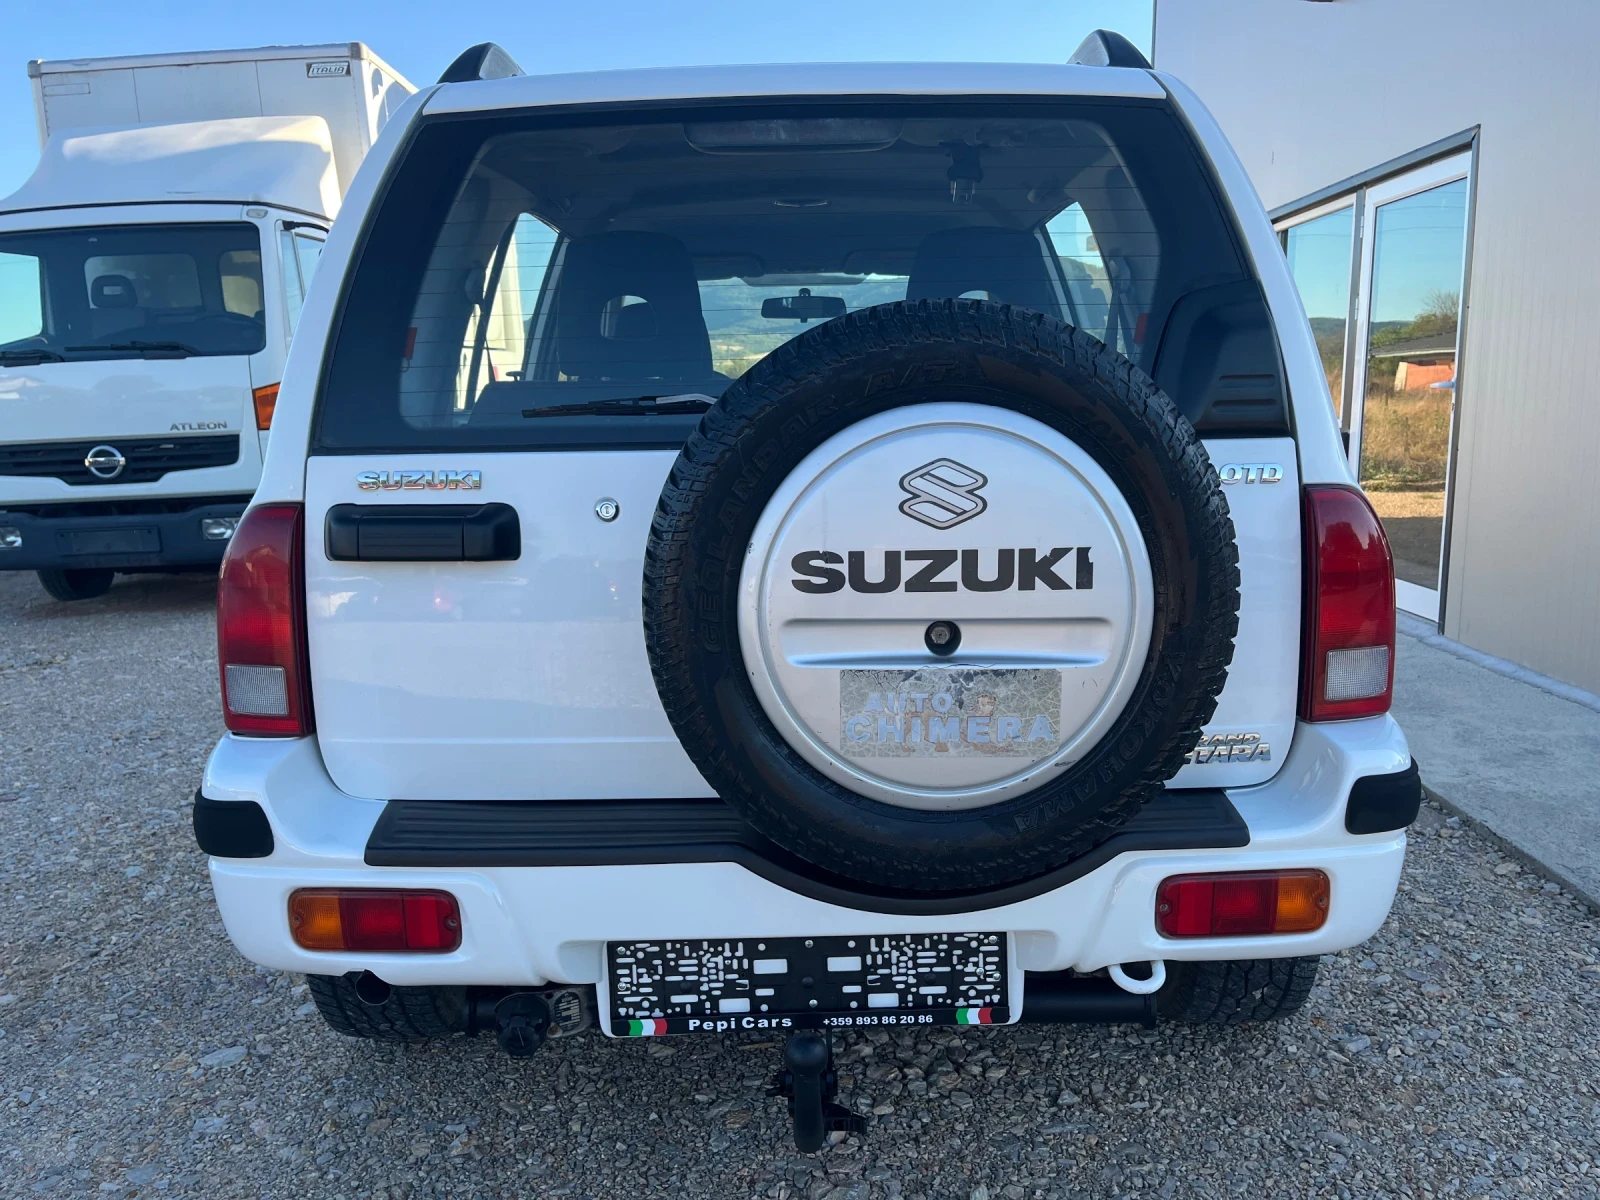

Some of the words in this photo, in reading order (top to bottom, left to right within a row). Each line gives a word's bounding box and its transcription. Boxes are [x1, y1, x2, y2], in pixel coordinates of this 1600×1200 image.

[311, 66, 345, 75] ITALIA
[169, 421, 228, 431] ATLEON
[356, 469, 482, 490] SUZUKI
[699, 394, 840, 655] GEOLANDAR
[790, 547, 1094, 594] SUZUKI
[863, 692, 953, 713] AUTO
[845, 714, 1055, 743] CHIMERA
[1012, 651, 1186, 834] YOKOHAMA
[688, 1017, 736, 1032] Pepi
[741, 1016, 793, 1029] Cars
[822, 1016, 853, 1026] +359
[855, 1016, 879, 1025] 893
[881, 1015, 897, 1024] 86
[899, 1015, 915, 1024] 20
[917, 1014, 934, 1023] 86
